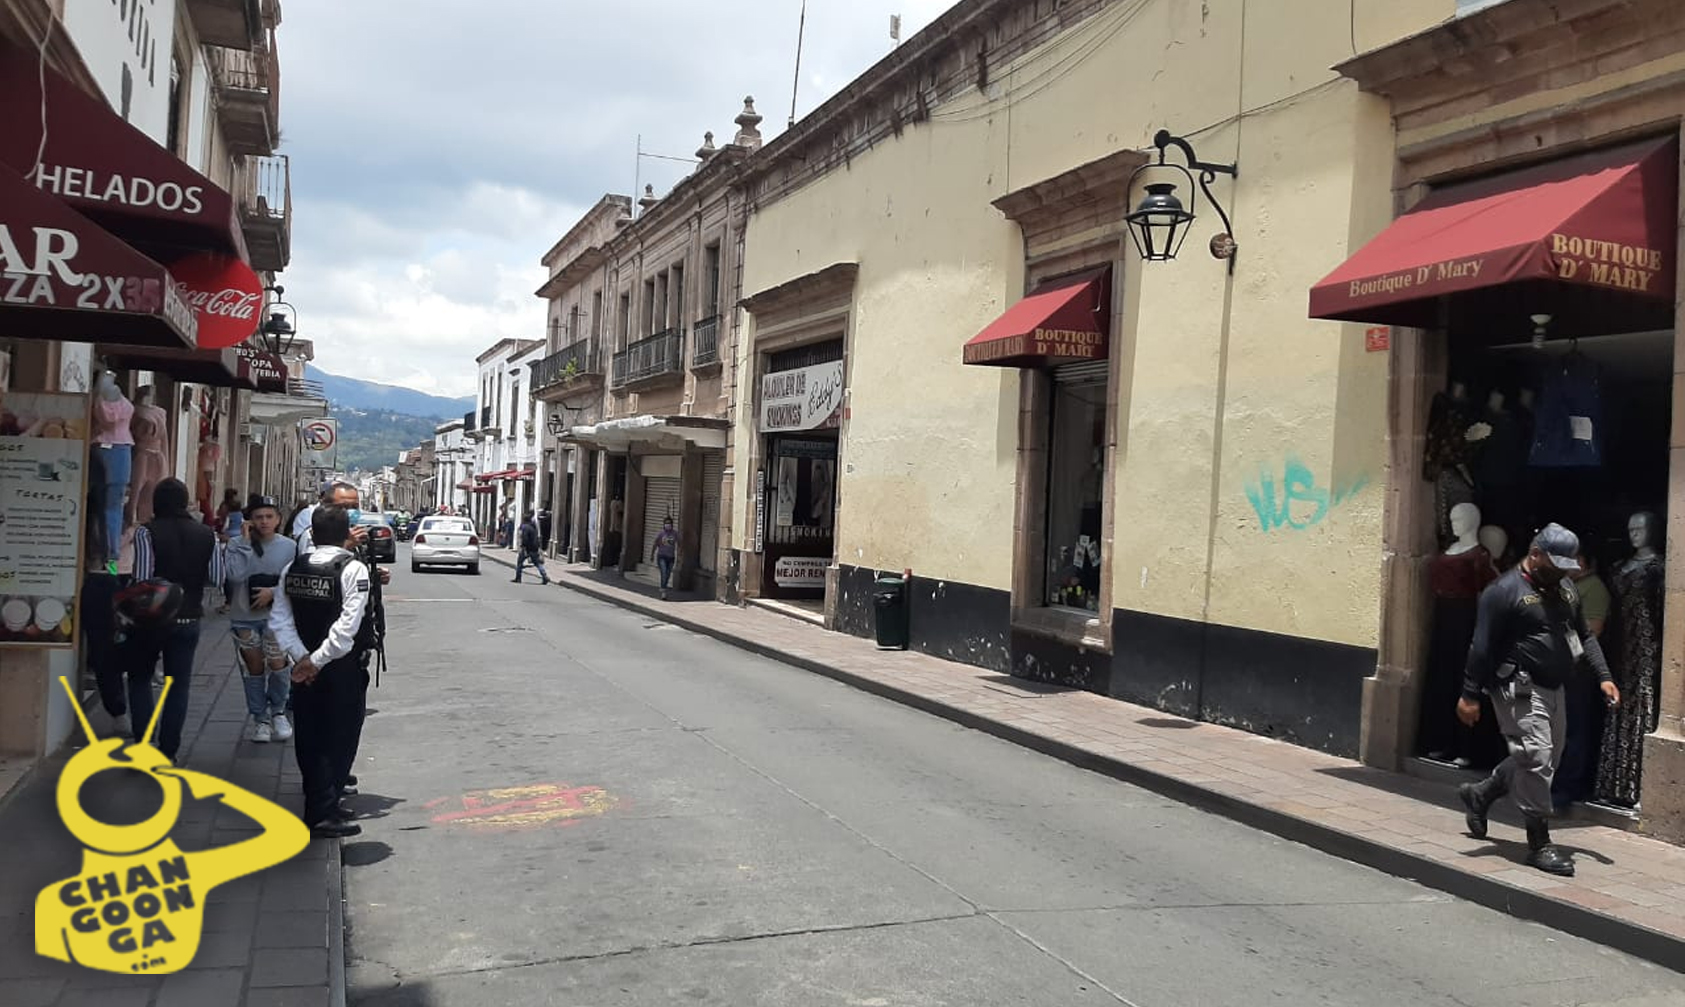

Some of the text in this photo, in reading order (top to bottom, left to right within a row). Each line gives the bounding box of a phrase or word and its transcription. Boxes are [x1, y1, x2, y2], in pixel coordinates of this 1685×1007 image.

[35, 163, 203, 214] HELADOS
[1553, 233, 1661, 272] BOUTIQUE
[1349, 273, 1412, 298] Boutique
[1437, 258, 1484, 280] Mary
[1589, 263, 1652, 292] MARY
[1034, 328, 1103, 346] BOUTIQUE
[1054, 342, 1095, 357] MARY
[244, 358, 272, 369] OPA
[776, 568, 826, 578] MEJOR REN
